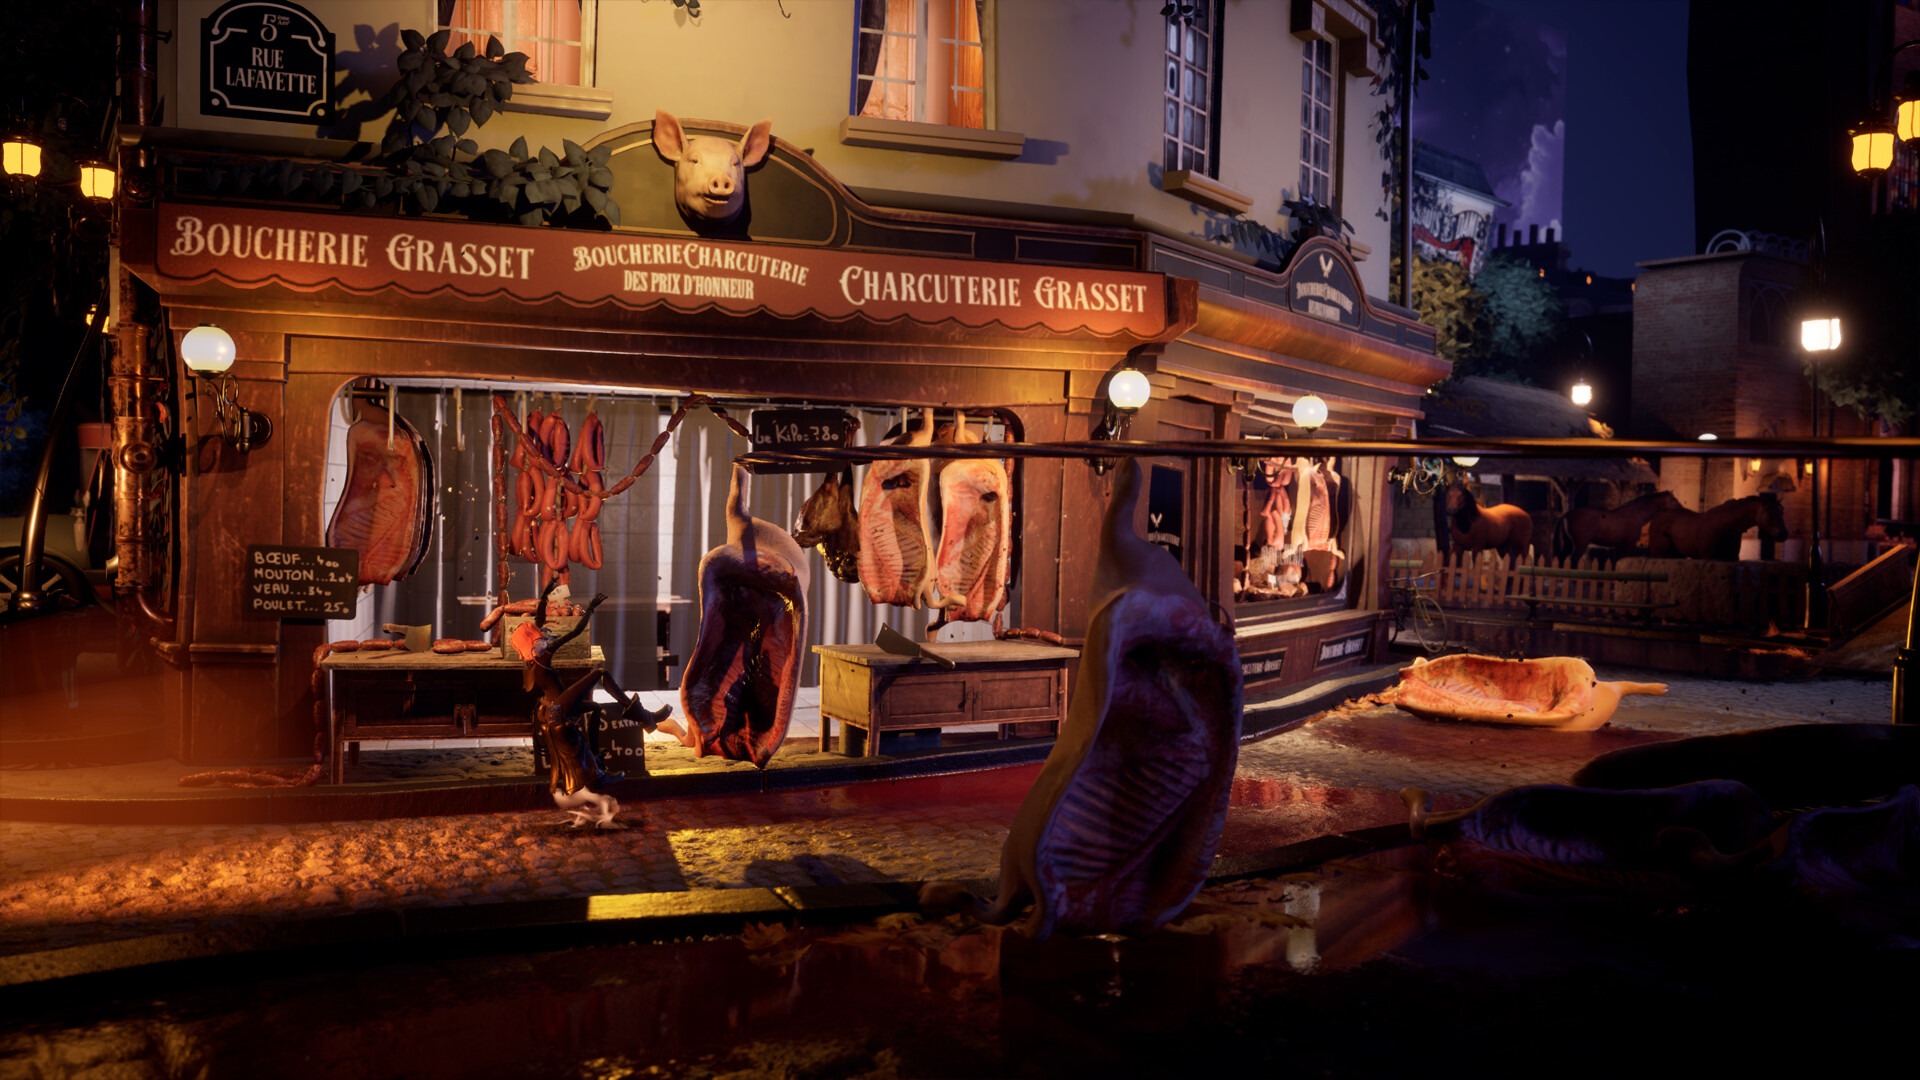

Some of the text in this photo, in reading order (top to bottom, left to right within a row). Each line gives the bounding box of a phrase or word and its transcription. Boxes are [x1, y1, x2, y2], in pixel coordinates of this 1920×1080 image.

[251, 46, 284, 70] RUE
[226, 66, 317, 95] LAFAYETTE
[170, 216, 535, 280] BOUCHERIE GRASSET
[623, 269, 755, 300] DES PRIX D'HONNEUR
[839, 265, 1148, 313] CHARCUTERIE GRASSET
